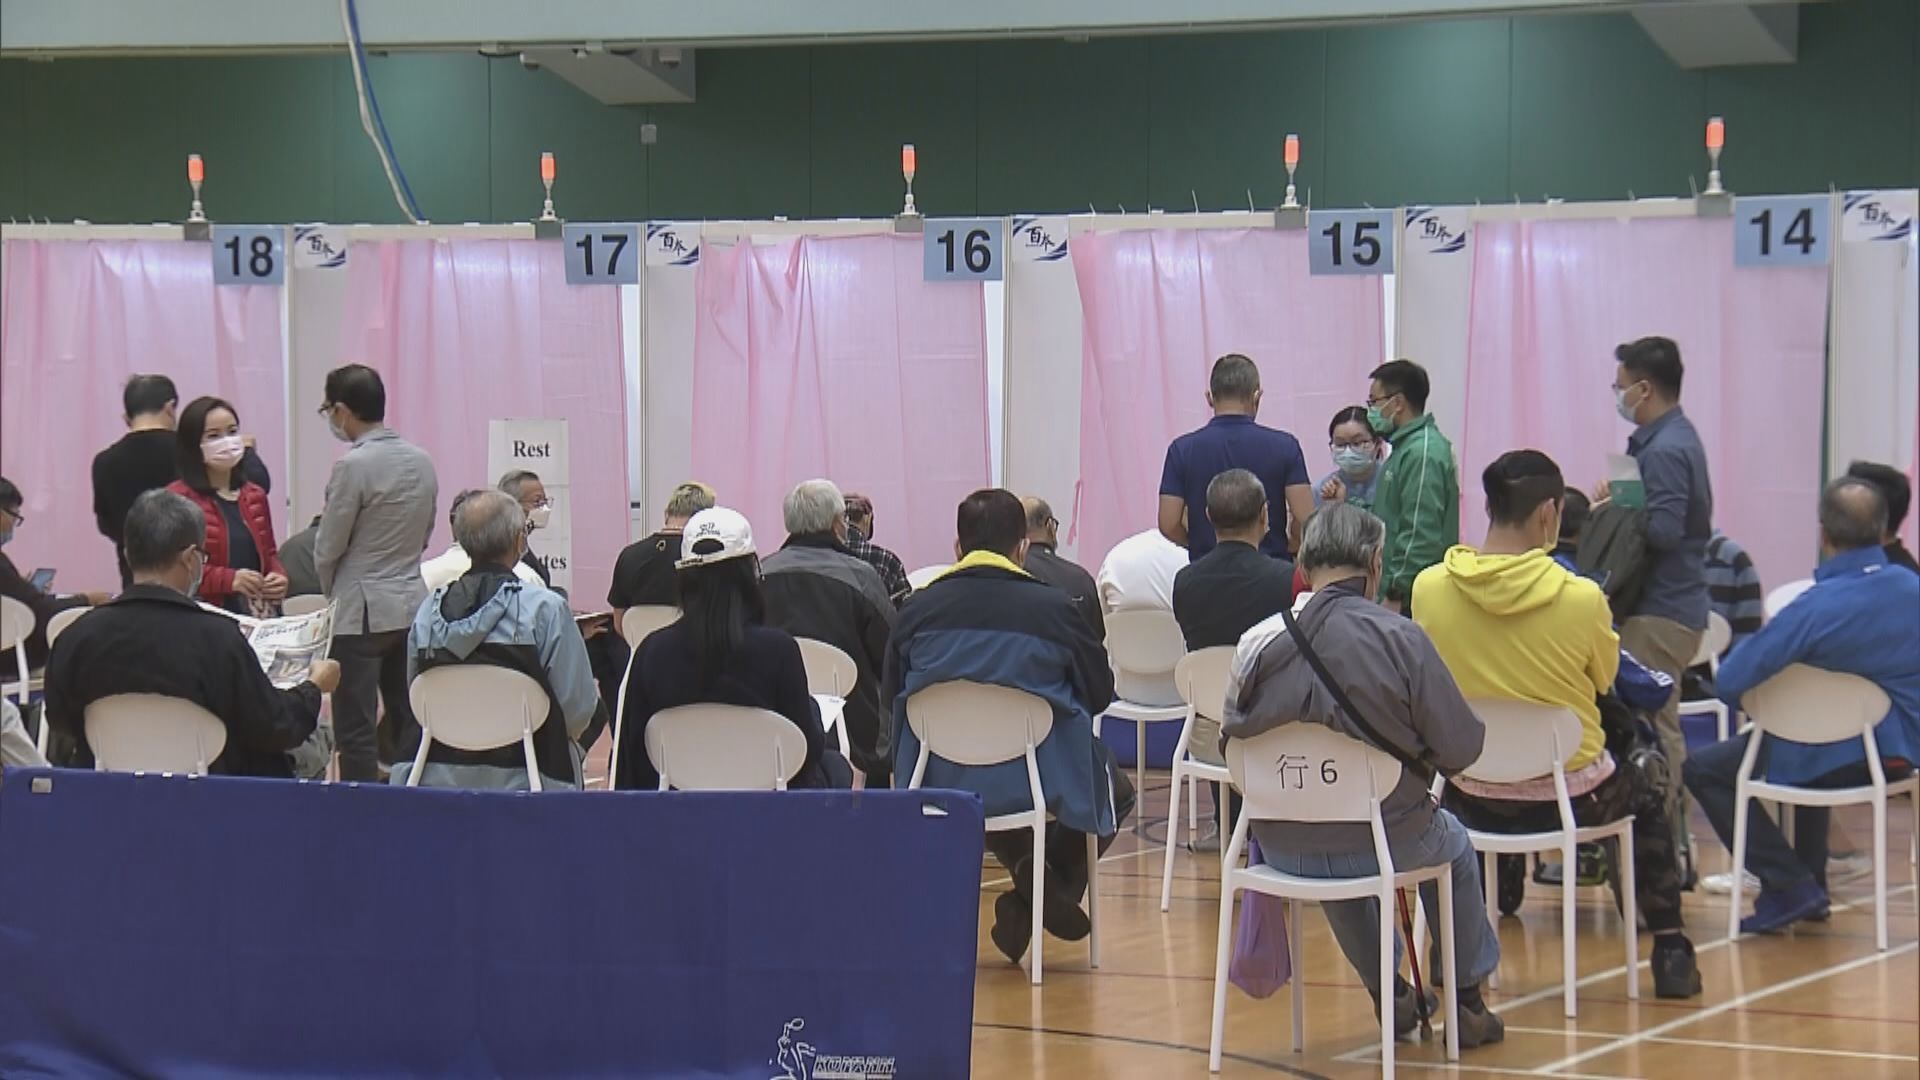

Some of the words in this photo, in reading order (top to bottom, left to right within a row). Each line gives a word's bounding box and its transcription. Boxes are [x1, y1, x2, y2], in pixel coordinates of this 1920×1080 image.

[937, 229, 992, 274] 16
[1323, 221, 1381, 267] 15
[1750, 208, 1817, 256] 14
[225, 235, 273, 278] 18
[576, 234, 629, 277] 17
[514, 440, 551, 458] Rest
[1275, 754, 1309, 789] 行
[1320, 758, 1338, 785] 6
